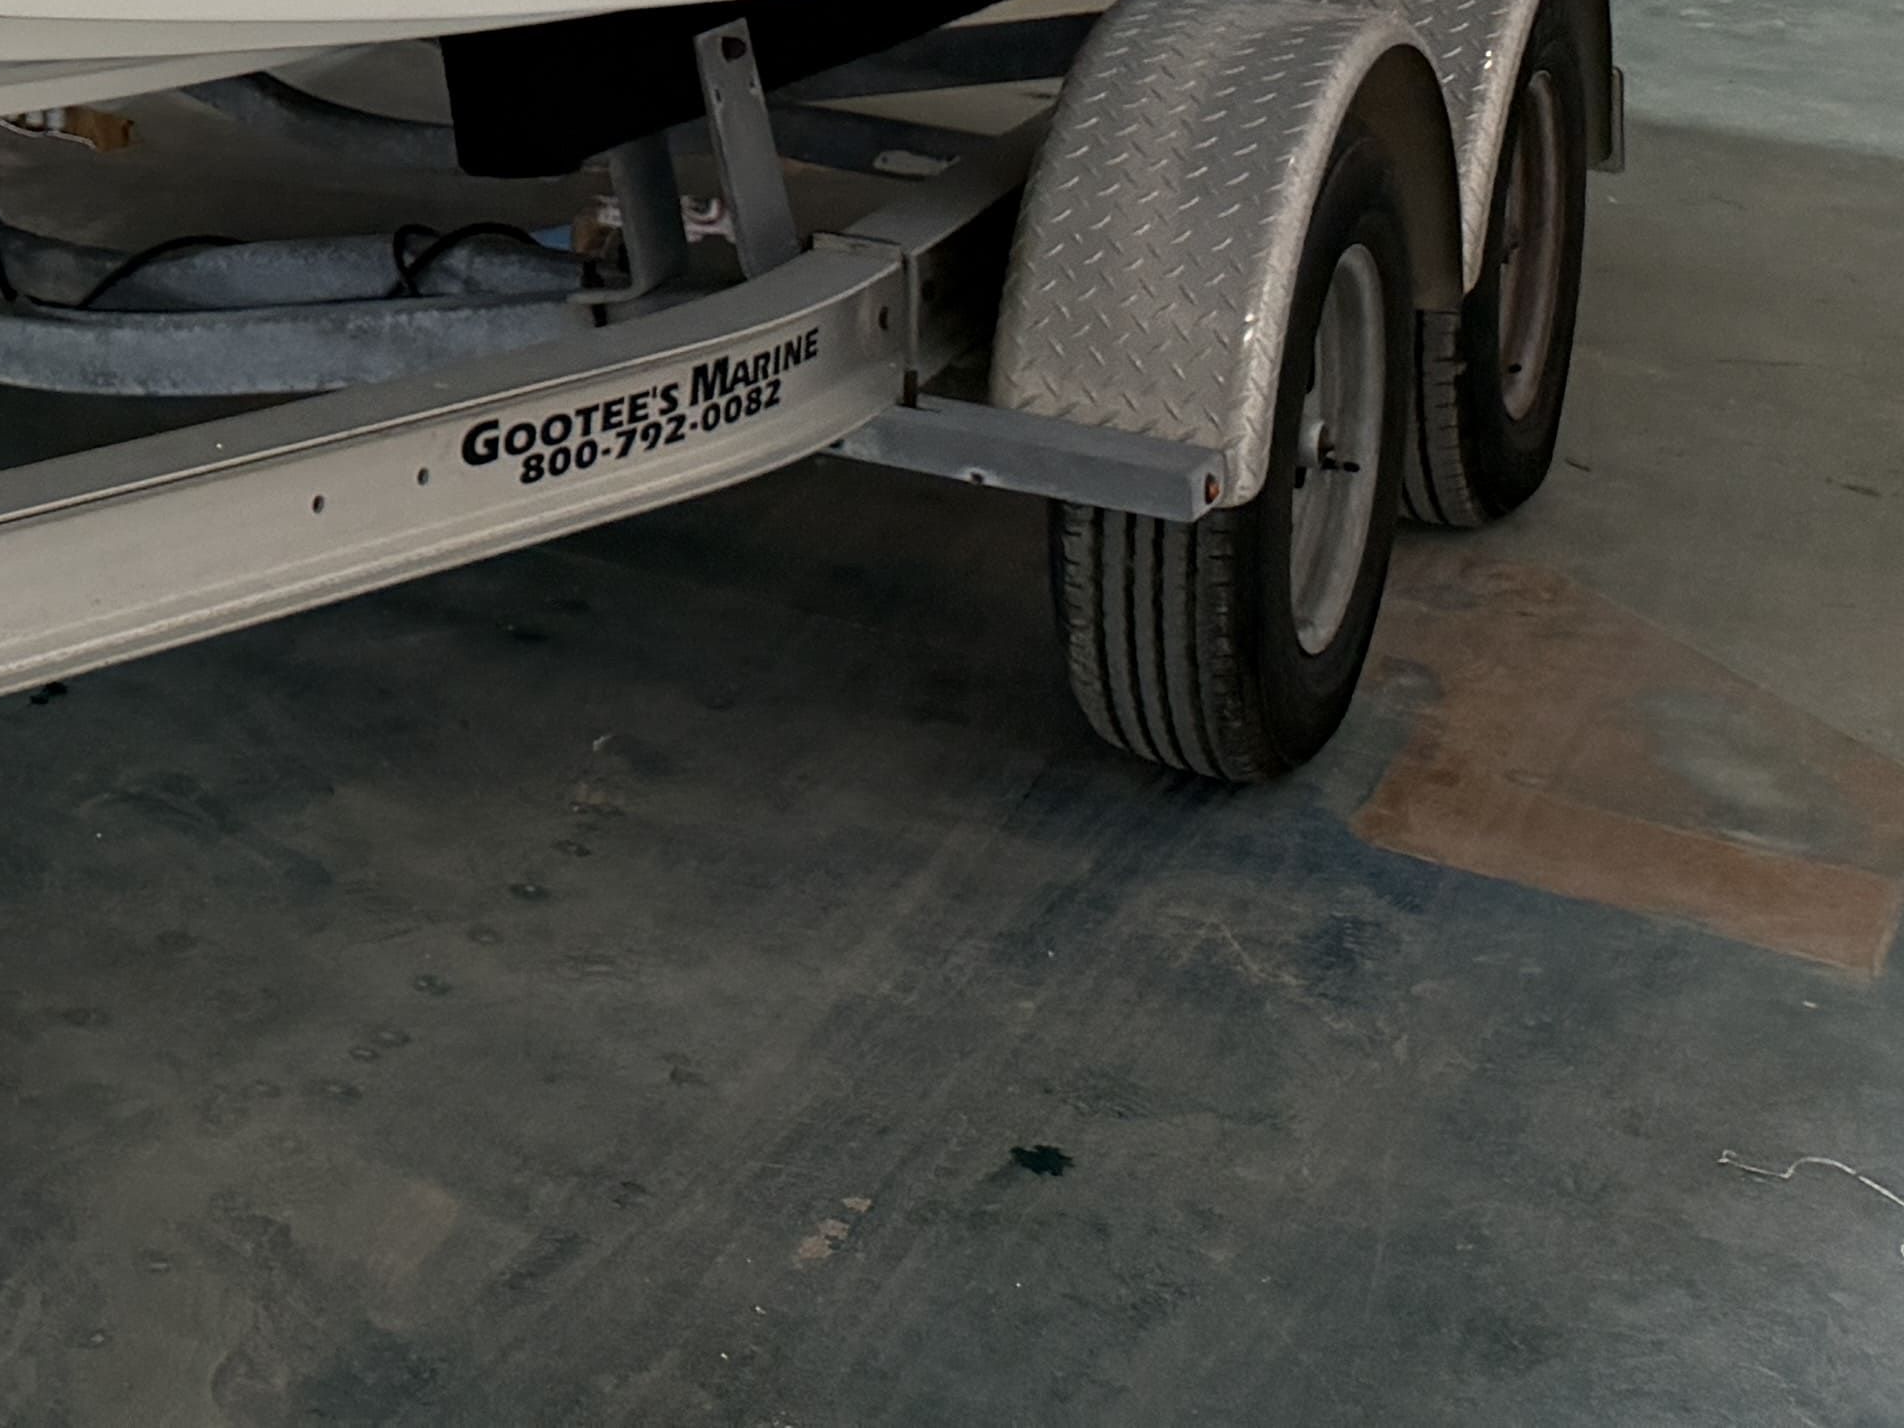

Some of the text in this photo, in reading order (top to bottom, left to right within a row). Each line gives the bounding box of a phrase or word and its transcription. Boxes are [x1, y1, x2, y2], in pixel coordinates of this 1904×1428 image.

[461, 327, 820, 467] GOOTEE'S MARINE
[519, 378, 782, 485] 800-792-0082
